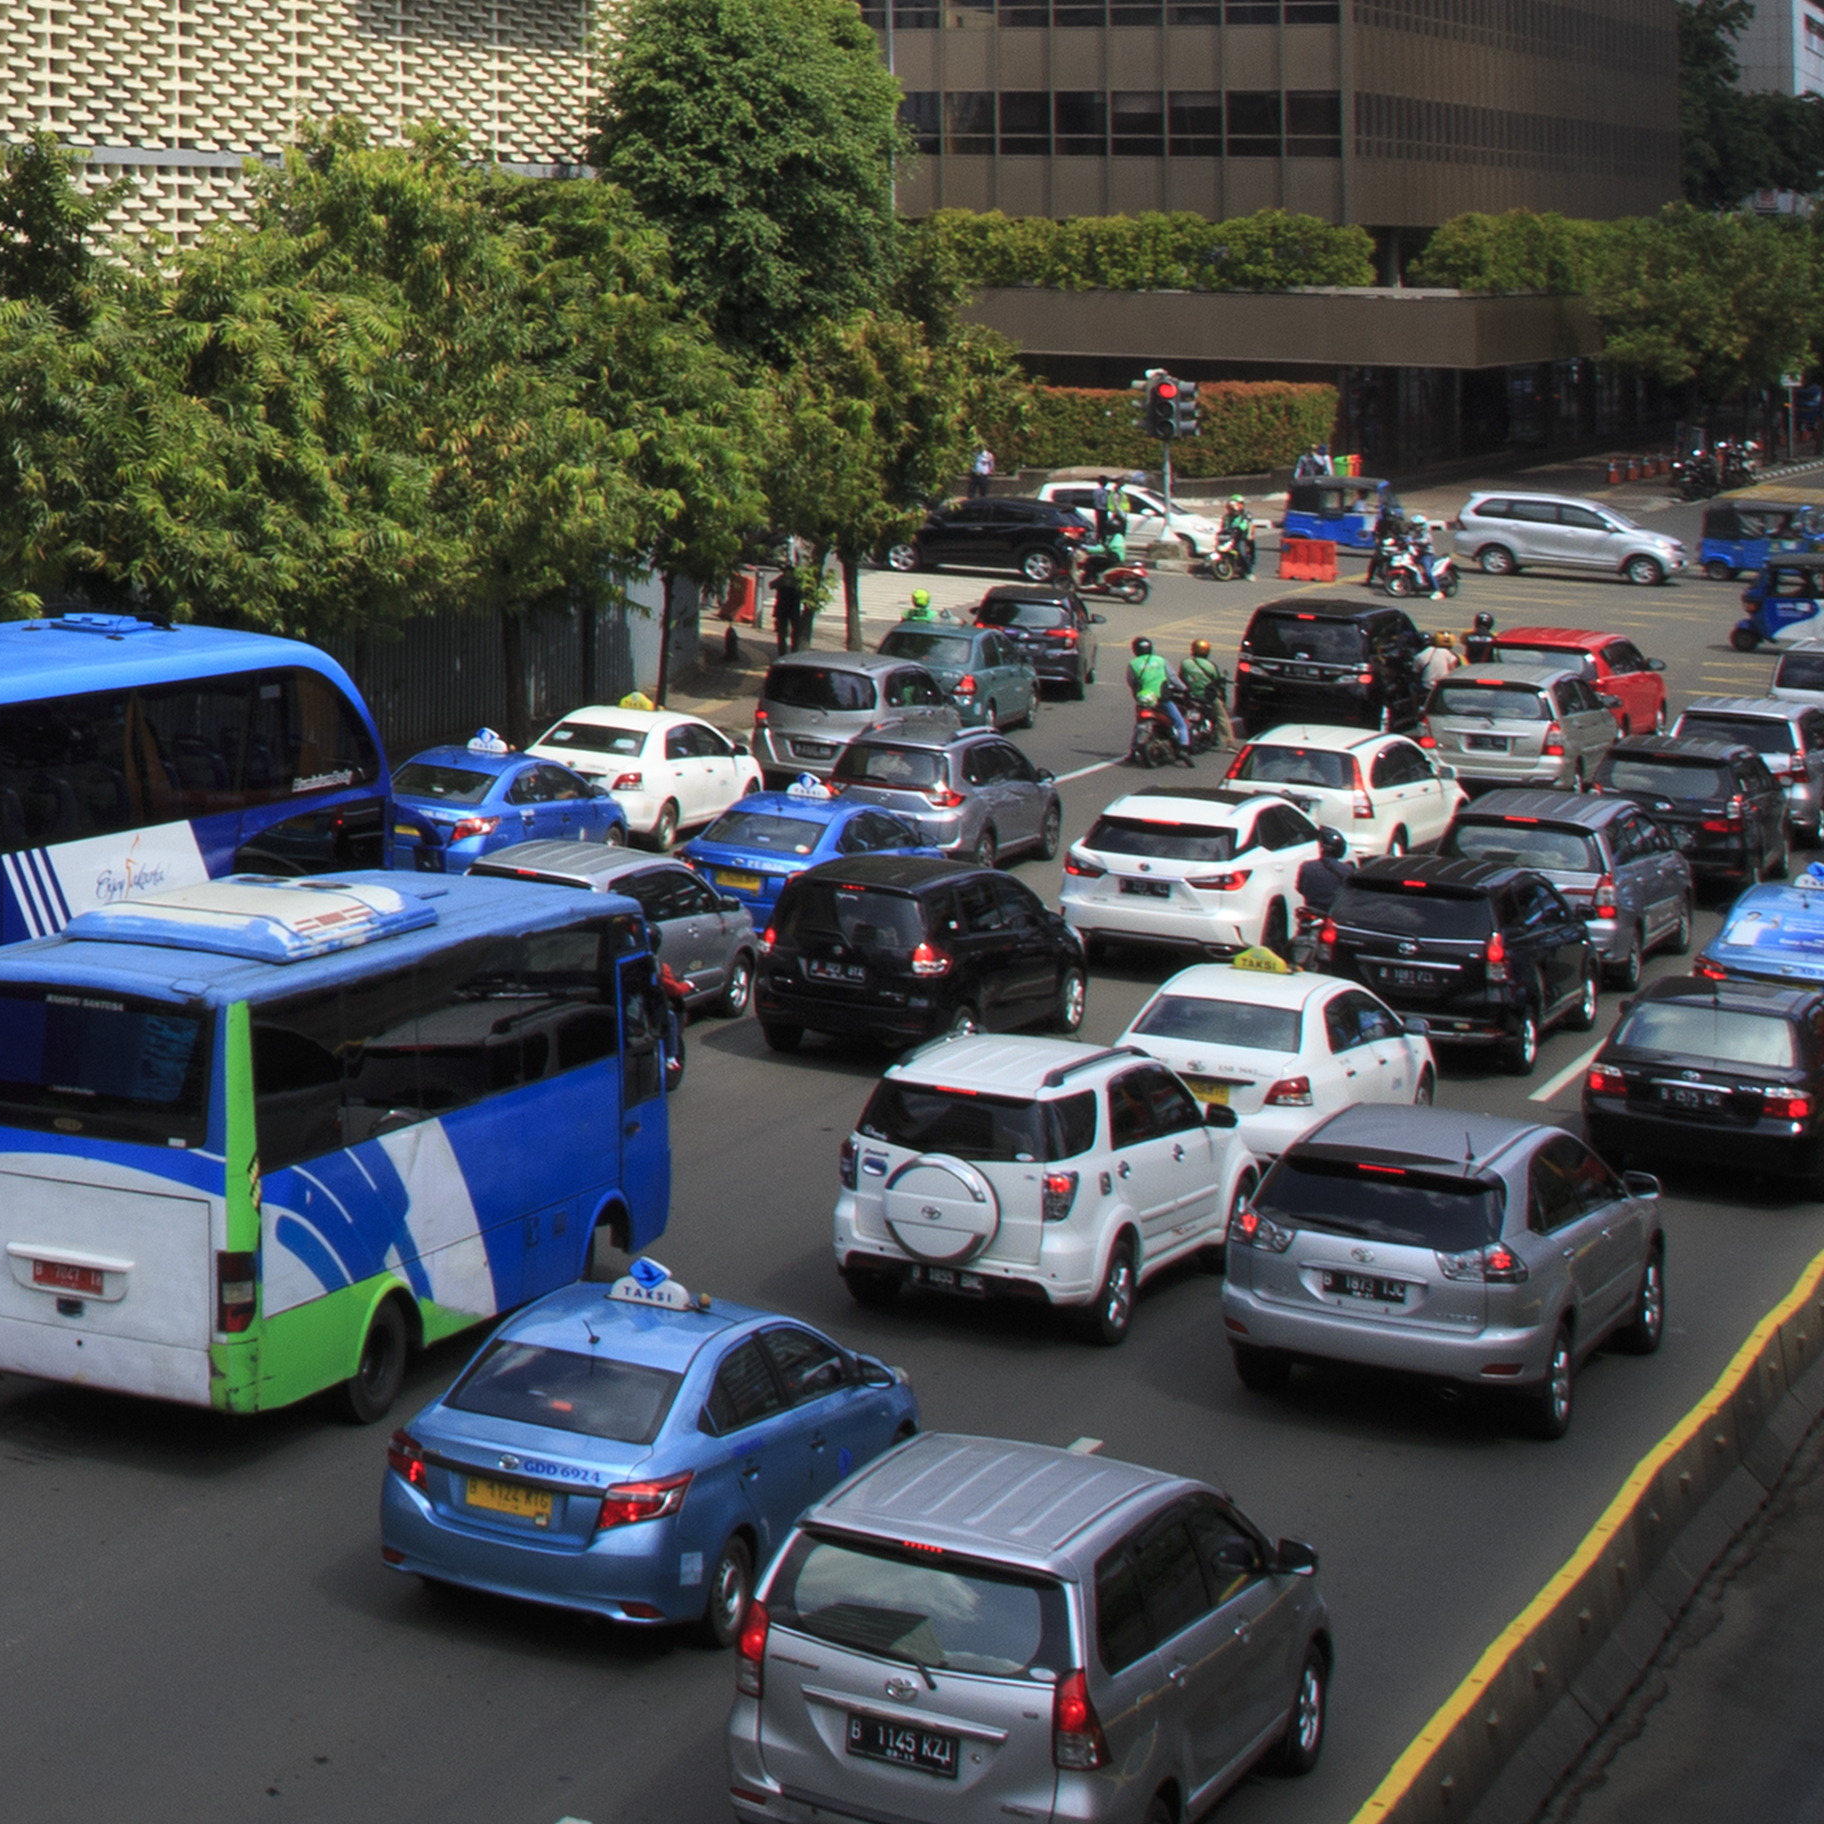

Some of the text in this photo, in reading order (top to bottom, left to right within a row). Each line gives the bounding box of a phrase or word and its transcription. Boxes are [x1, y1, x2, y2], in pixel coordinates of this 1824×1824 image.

[1241, 957, 1277, 971] TAKSI
[35, 1261, 43, 1276] B
[1324, 1272, 1333, 1287] B
[623, 1285, 672, 1303] TAKSI
[523, 1460, 601, 1484] GDD 6924
[469, 1480, 478, 1494] B
[852, 1719, 862, 1740] B
[878, 1725, 916, 1753] 1145
